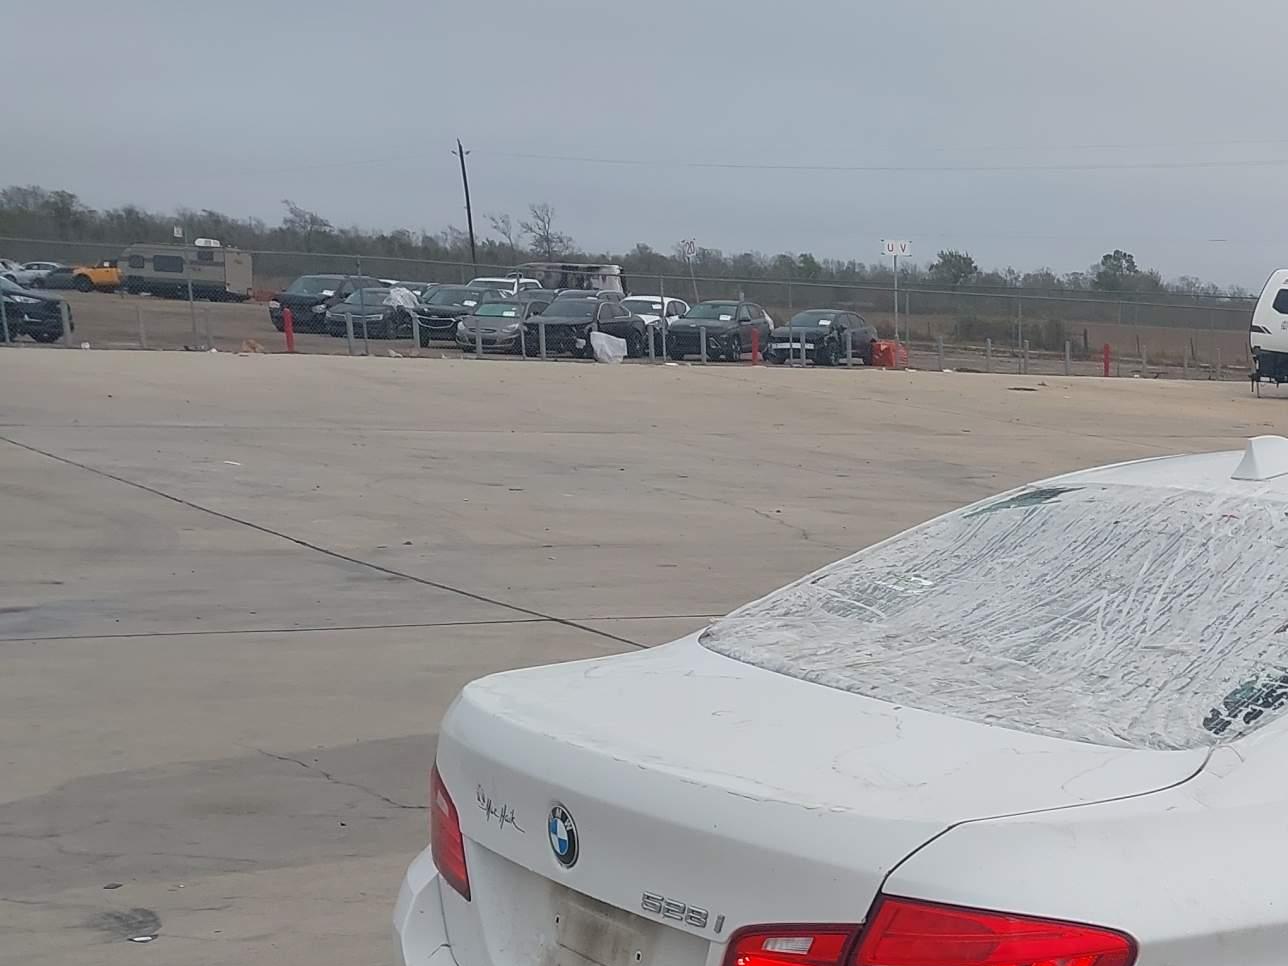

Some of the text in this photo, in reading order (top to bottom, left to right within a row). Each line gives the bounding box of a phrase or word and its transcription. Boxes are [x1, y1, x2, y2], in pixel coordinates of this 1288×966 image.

[887, 243, 907, 253] U V
[641, 891, 726, 934] 528i
